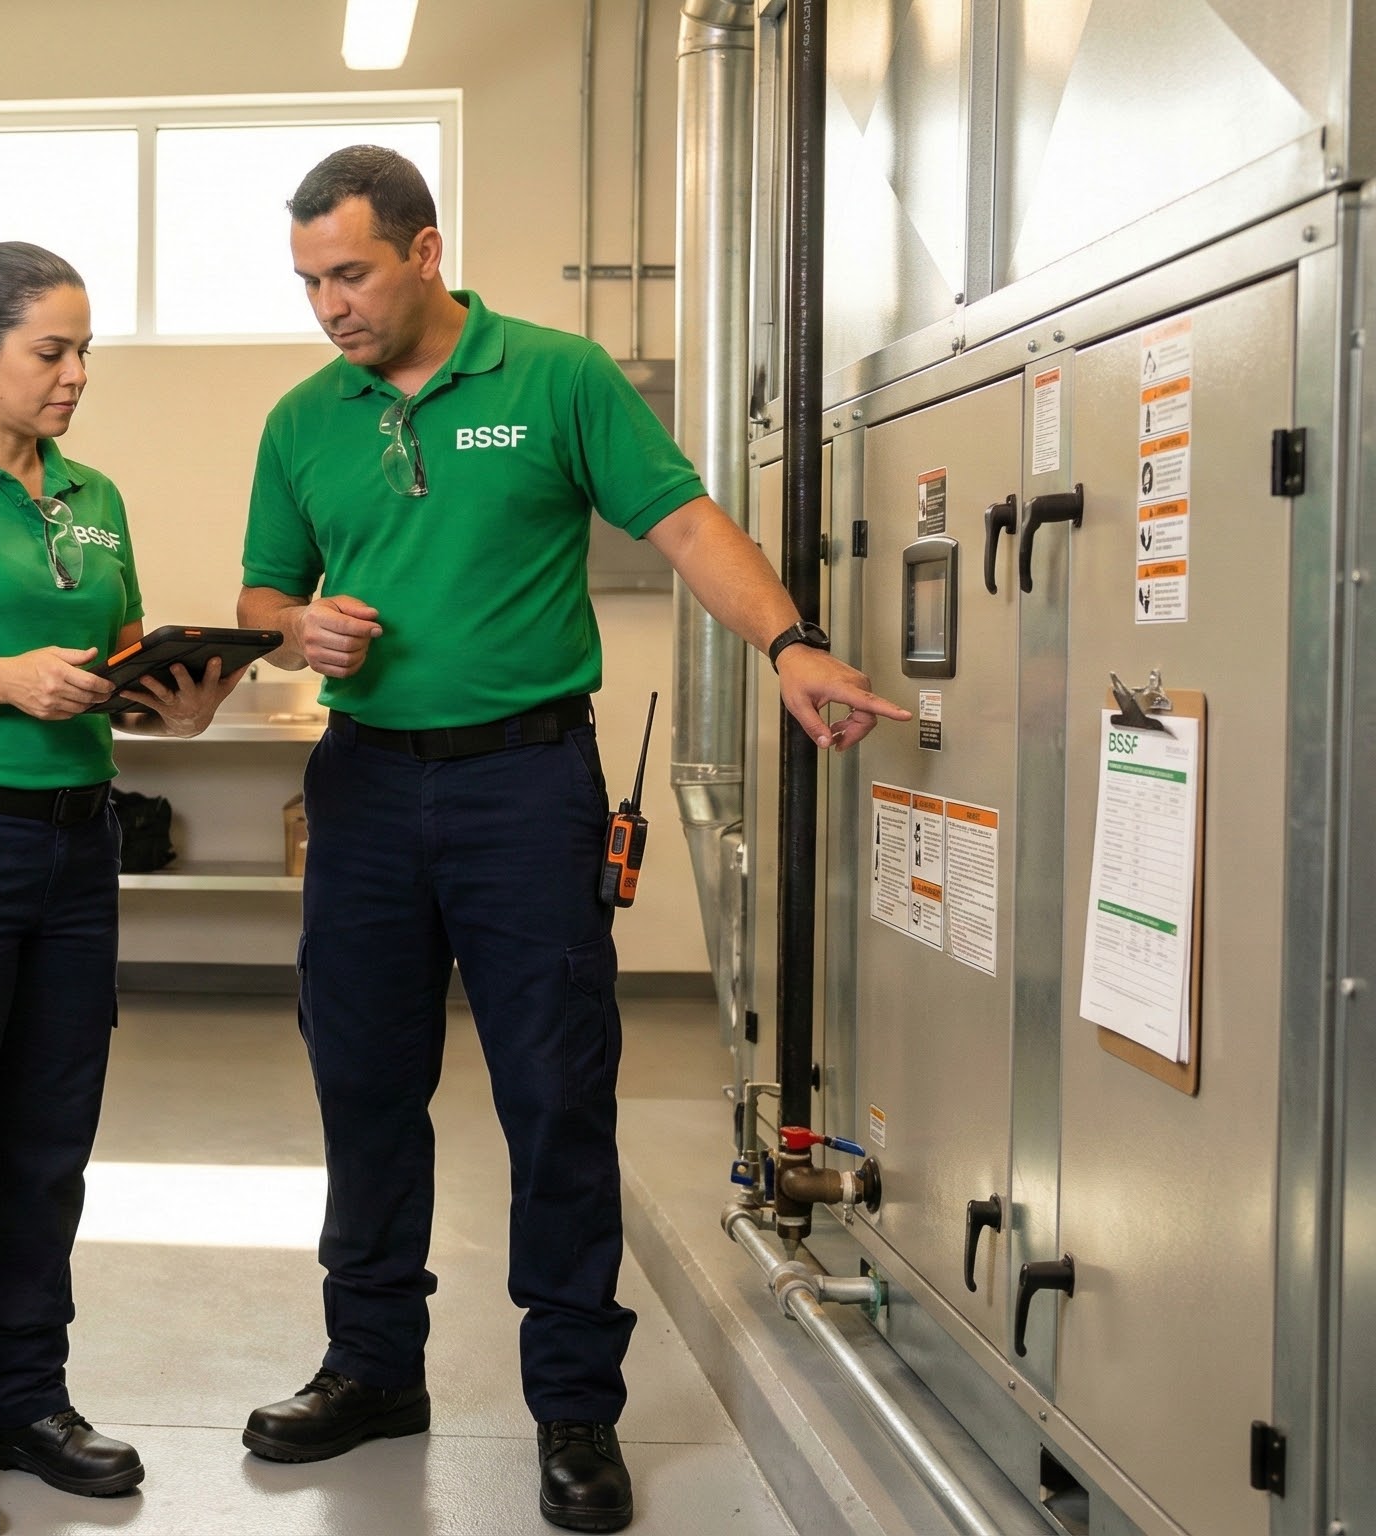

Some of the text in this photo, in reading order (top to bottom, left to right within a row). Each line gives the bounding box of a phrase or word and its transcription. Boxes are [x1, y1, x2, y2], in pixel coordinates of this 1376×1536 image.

[456, 425, 528, 450] BSSF
[72, 525, 121, 552] BSSF
[1108, 732, 1139, 755] BSSF
